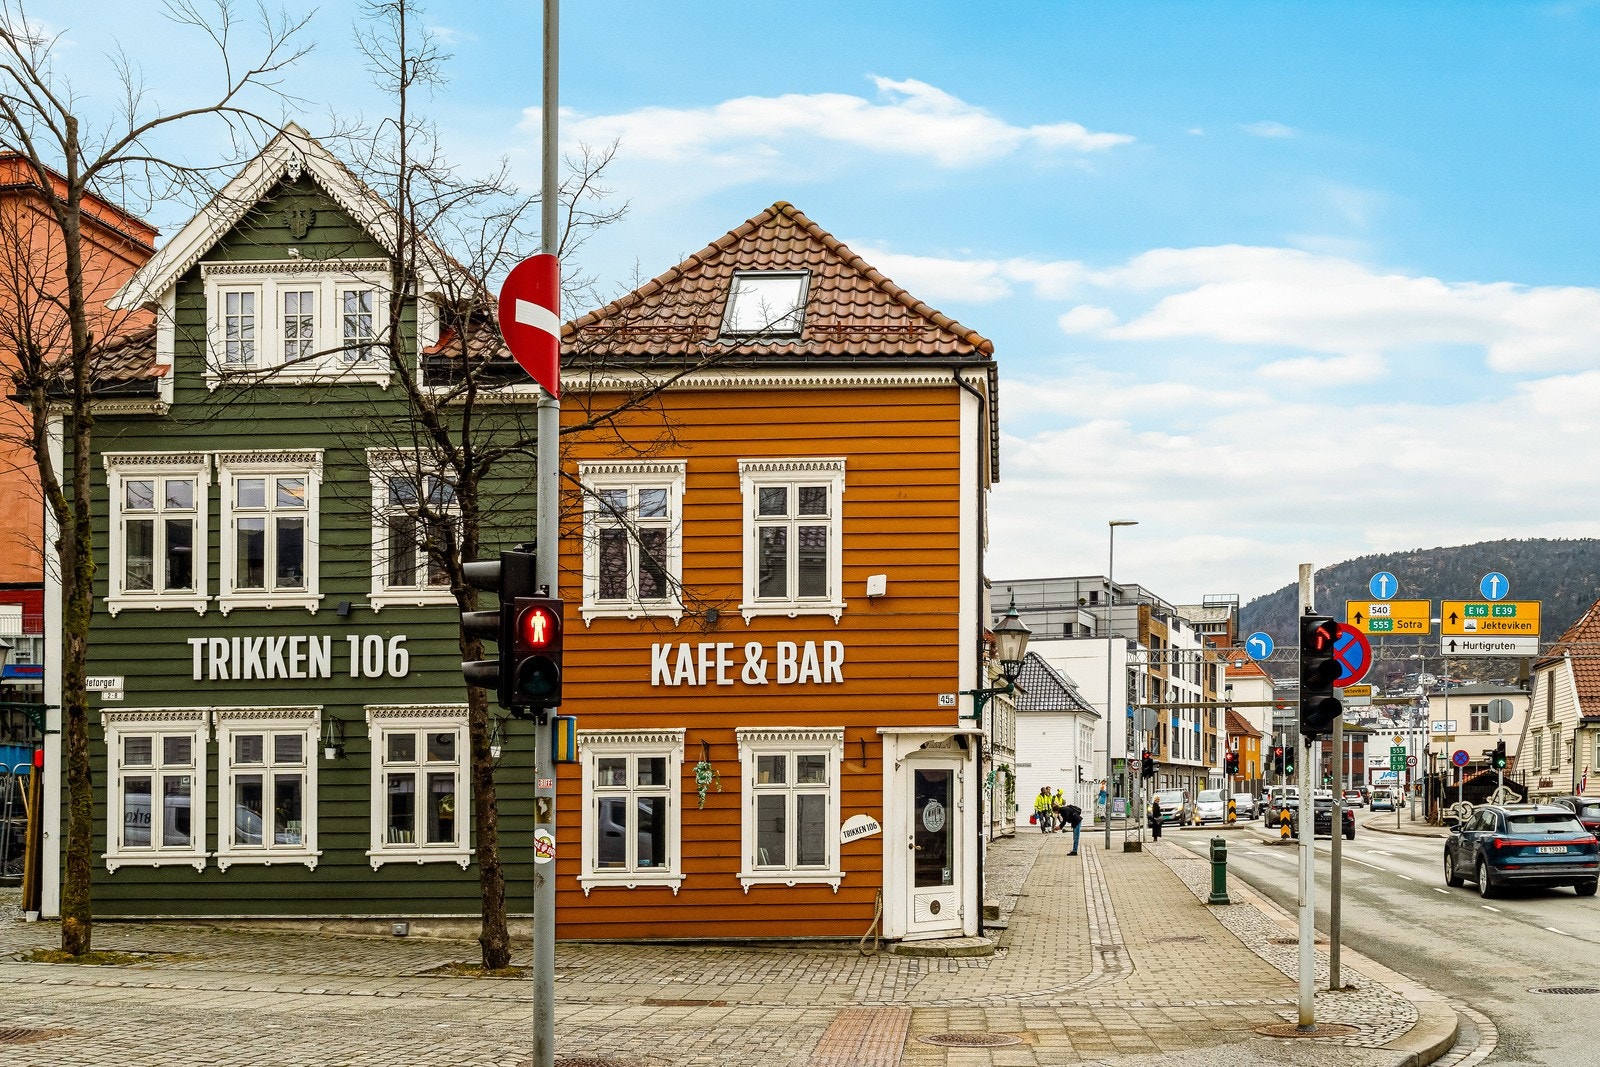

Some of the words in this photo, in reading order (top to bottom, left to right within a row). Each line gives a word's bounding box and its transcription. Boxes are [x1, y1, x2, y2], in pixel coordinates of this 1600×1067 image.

[1372, 606, 1388, 614] 540
[1469, 606, 1474, 615] E
[1476, 606, 1485, 615] 16
[1495, 606, 1501, 615] E
[1502, 606, 1513, 615] 39
[1373, 621, 1389, 629] 555
[1397, 620, 1423, 629] Sotra
[1481, 621, 1532, 630] Jekteviken
[1462, 641, 1516, 652] Hurtigruten
[187, 635, 331, 681] TRIKKEN
[346, 634, 409, 679] 106
[651, 642, 734, 686] KAFE
[741, 641, 769, 685] &
[776, 640, 845, 685] BAR
[1379, 771, 1398, 779] JAS
[842, 824, 867, 839] TRIKKEN
[866, 821, 878, 832] 106
